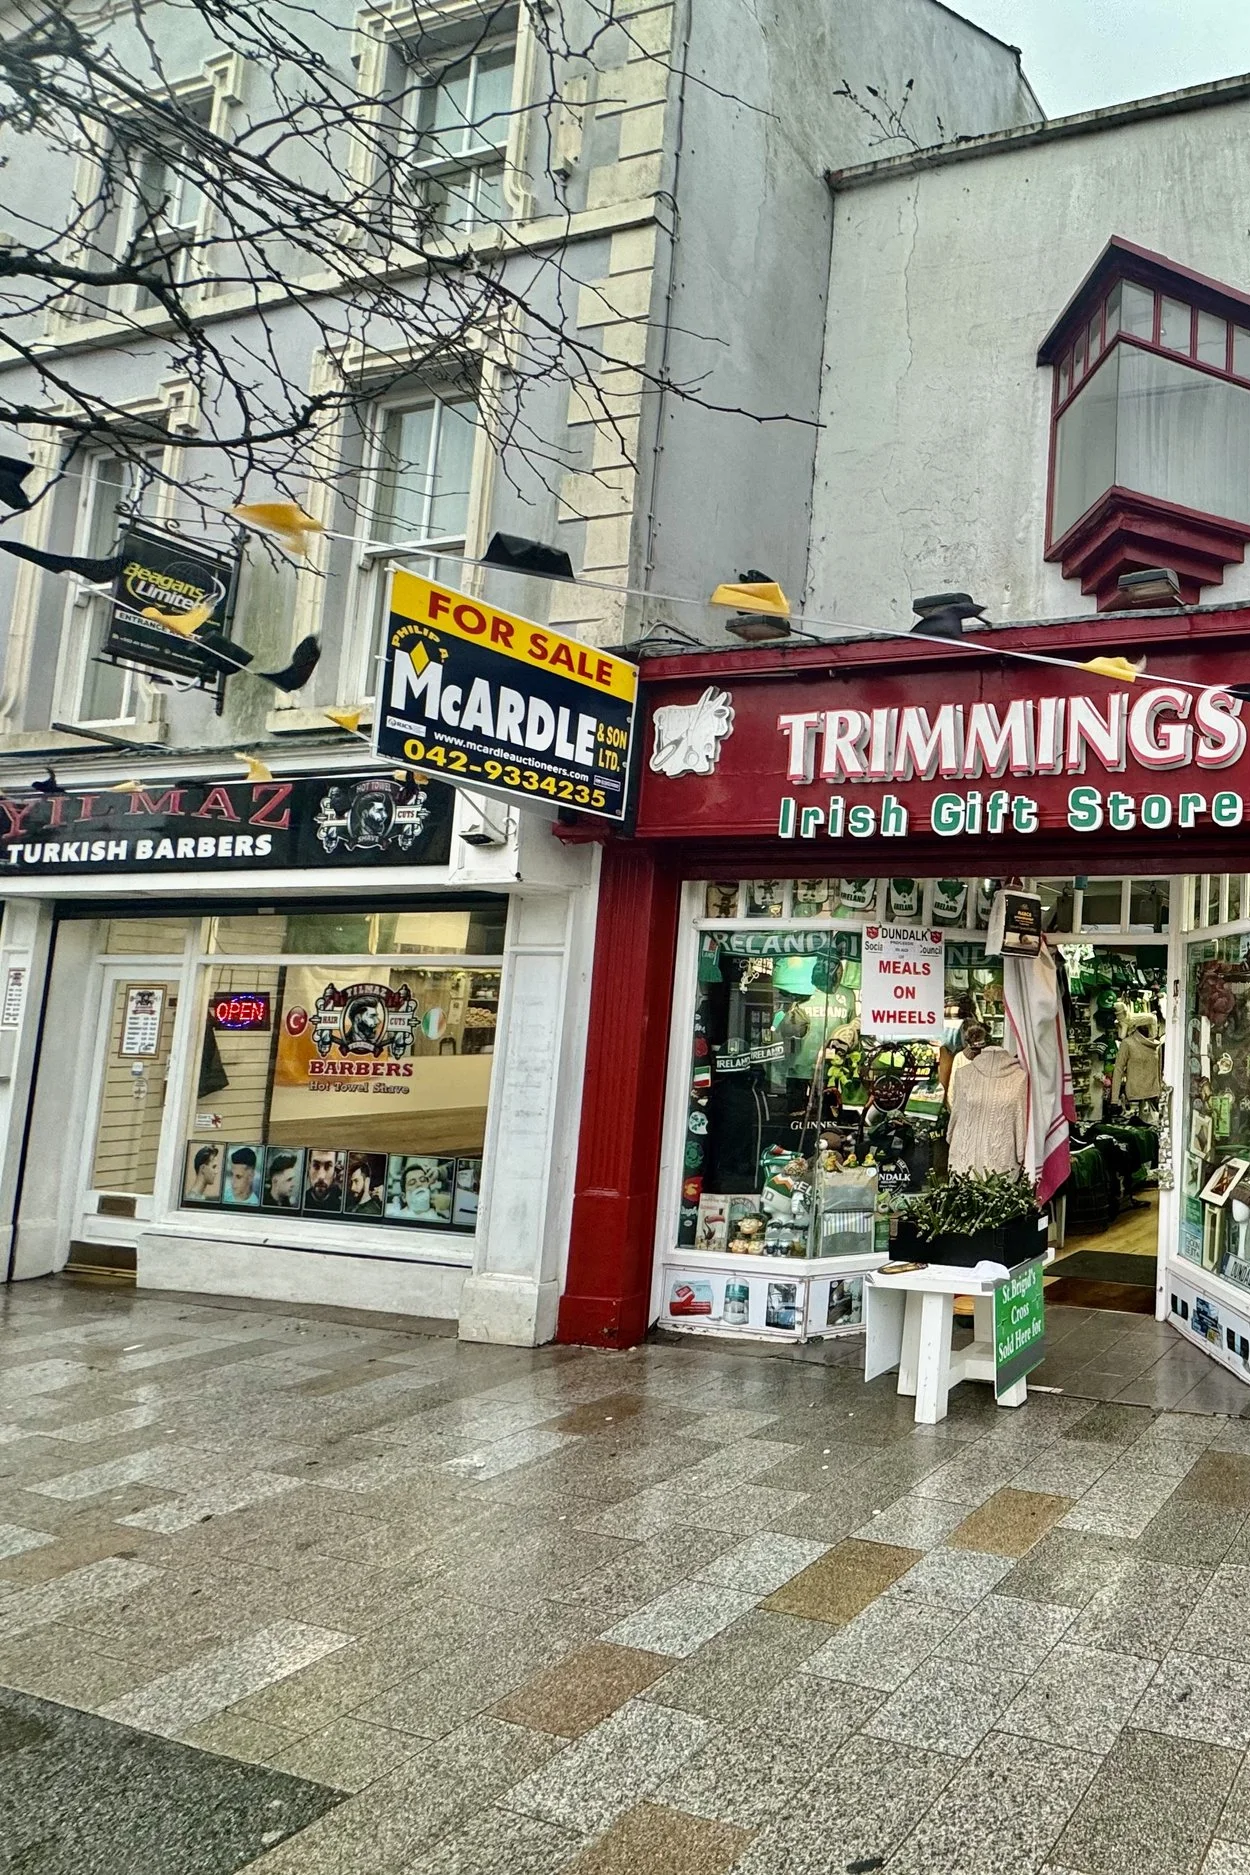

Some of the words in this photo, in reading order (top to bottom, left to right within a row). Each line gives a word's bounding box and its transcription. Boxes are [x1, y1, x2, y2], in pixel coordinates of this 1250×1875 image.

[124, 562, 205, 598] Beagans
[391, 624, 441, 647] PHILIP
[428, 591, 515, 650] FOR
[527, 633, 614, 686] SALE
[390, 648, 598, 767] McARDLE
[596, 723, 606, 742] &
[607, 725, 628, 750] SON
[777, 686, 1246, 785] TRIMMINGS
[433, 730, 589, 782] www.mcardleauctioneers.com
[598, 748, 620, 772] LTD.
[403, 738, 606, 808] 042-9334235
[356, 783, 369, 793] HOT
[371, 781, 392, 792] TOWEL
[0, 783, 293, 839] YILMAZ
[778, 794, 908, 839] Irish
[931, 790, 1039, 838] Gift
[1067, 785, 1244, 833] Store
[7, 839, 128, 865] TURKISH
[136, 834, 272, 861] BARBERS
[713, 932, 827, 954] RELAND
[881, 927, 929, 942] DUNDALK
[879, 960, 931, 976] MEALS
[893, 985, 916, 1000] ON
[216, 1002, 263, 1021] OPEN
[322, 1015, 338, 1025] HAIR
[390, 1016, 406, 1025] CUTS
[871, 1009, 936, 1025] WHEELS
[309, 1060, 414, 1077] BARBERS
[309, 1080, 331, 1092] Hot
[335, 1082, 369, 1093] Towel
[373, 1082, 410, 1094] Shave
[1011, 1302, 1030, 1325] Cross
[999, 1334, 1014, 1363] Sold
[1015, 1328, 1031, 1351] Here
[1031, 1317, 1042, 1337] for
